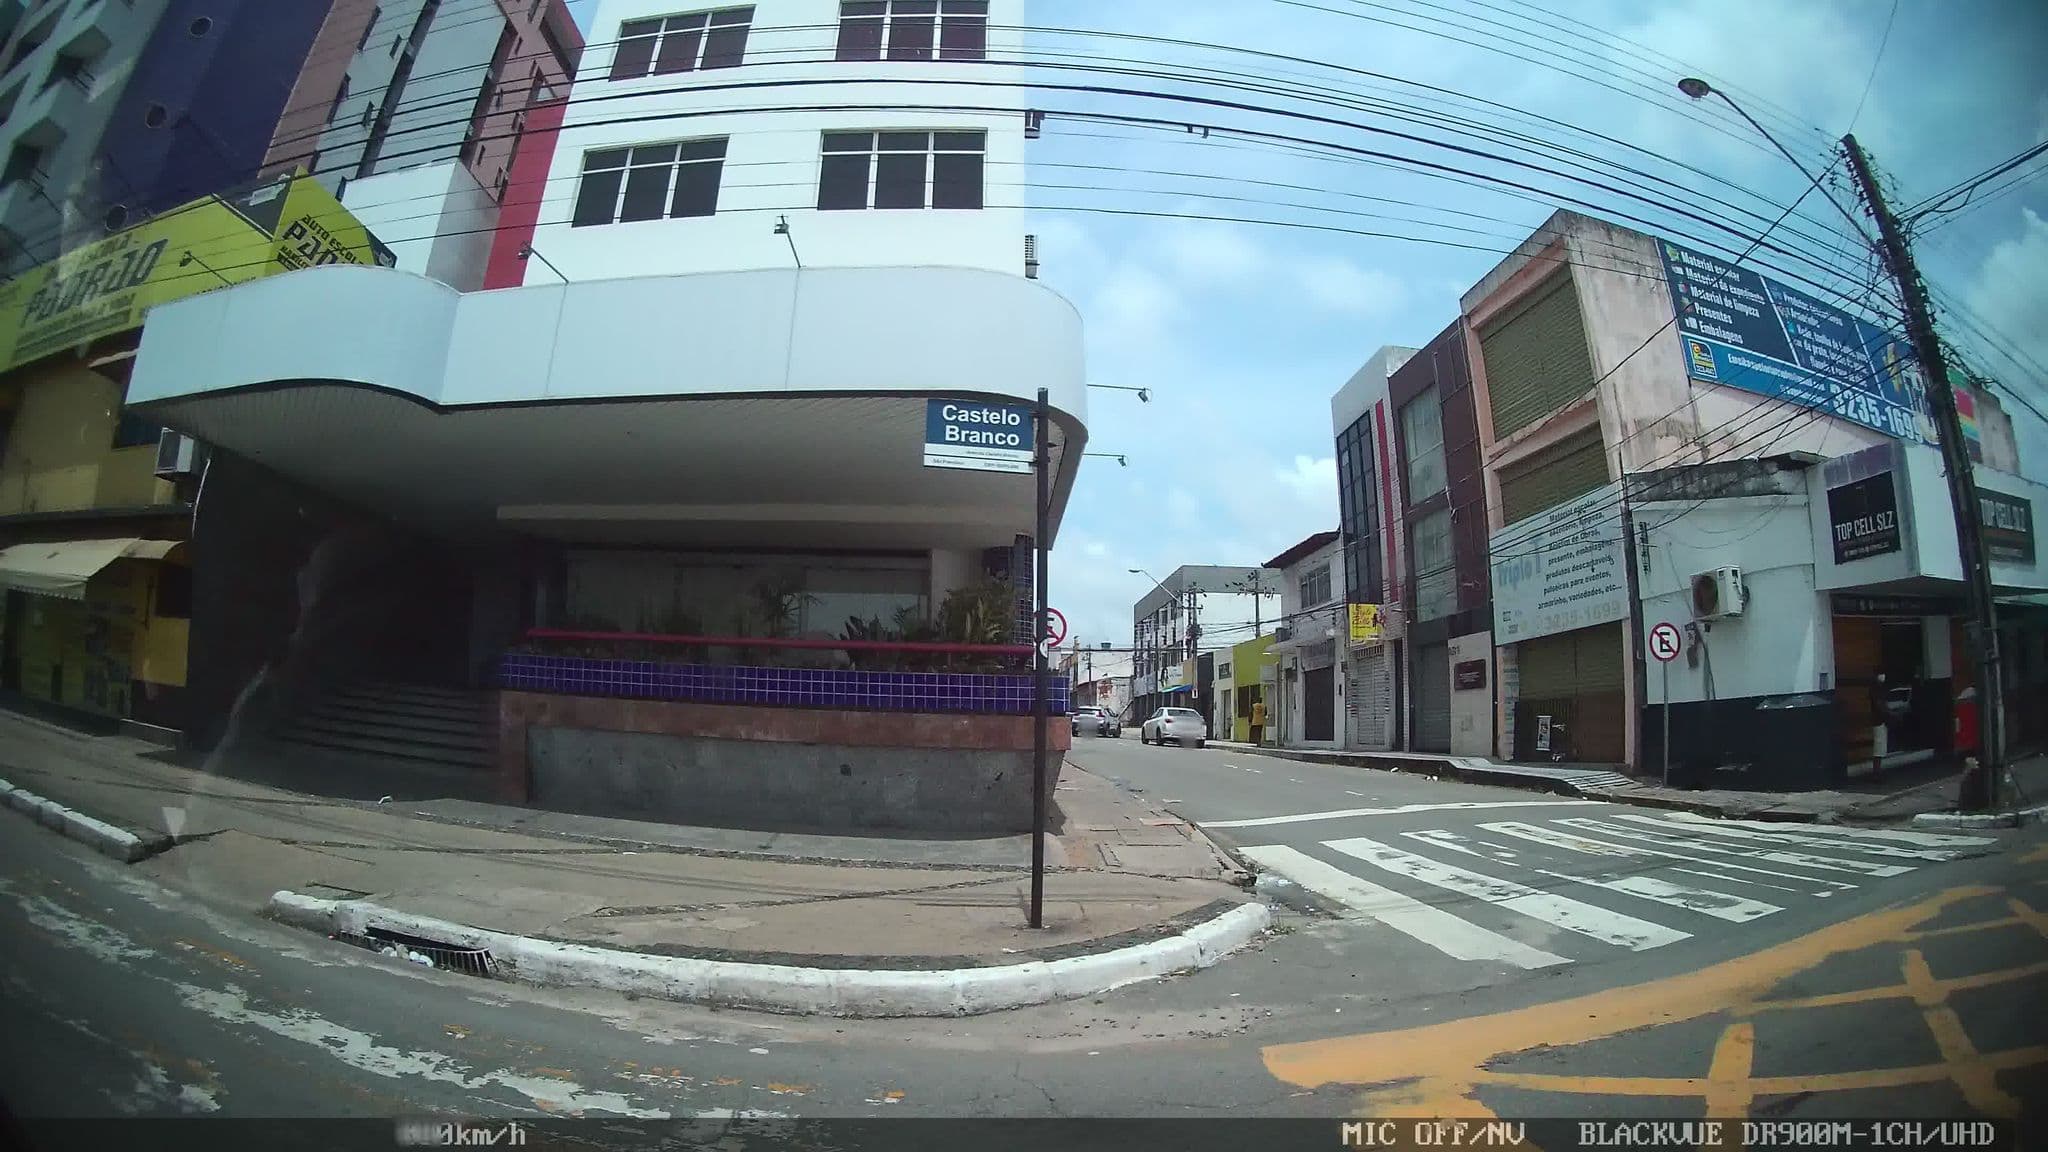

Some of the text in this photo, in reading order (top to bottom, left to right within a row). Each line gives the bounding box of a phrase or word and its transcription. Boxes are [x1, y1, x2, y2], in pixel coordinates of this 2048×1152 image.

[328, 238, 364, 265] ESCOL
[942, 404, 1021, 426] Castelo
[944, 425, 1020, 446] Branco
[1835, 510, 1895, 541] TOP CELL SLZ
